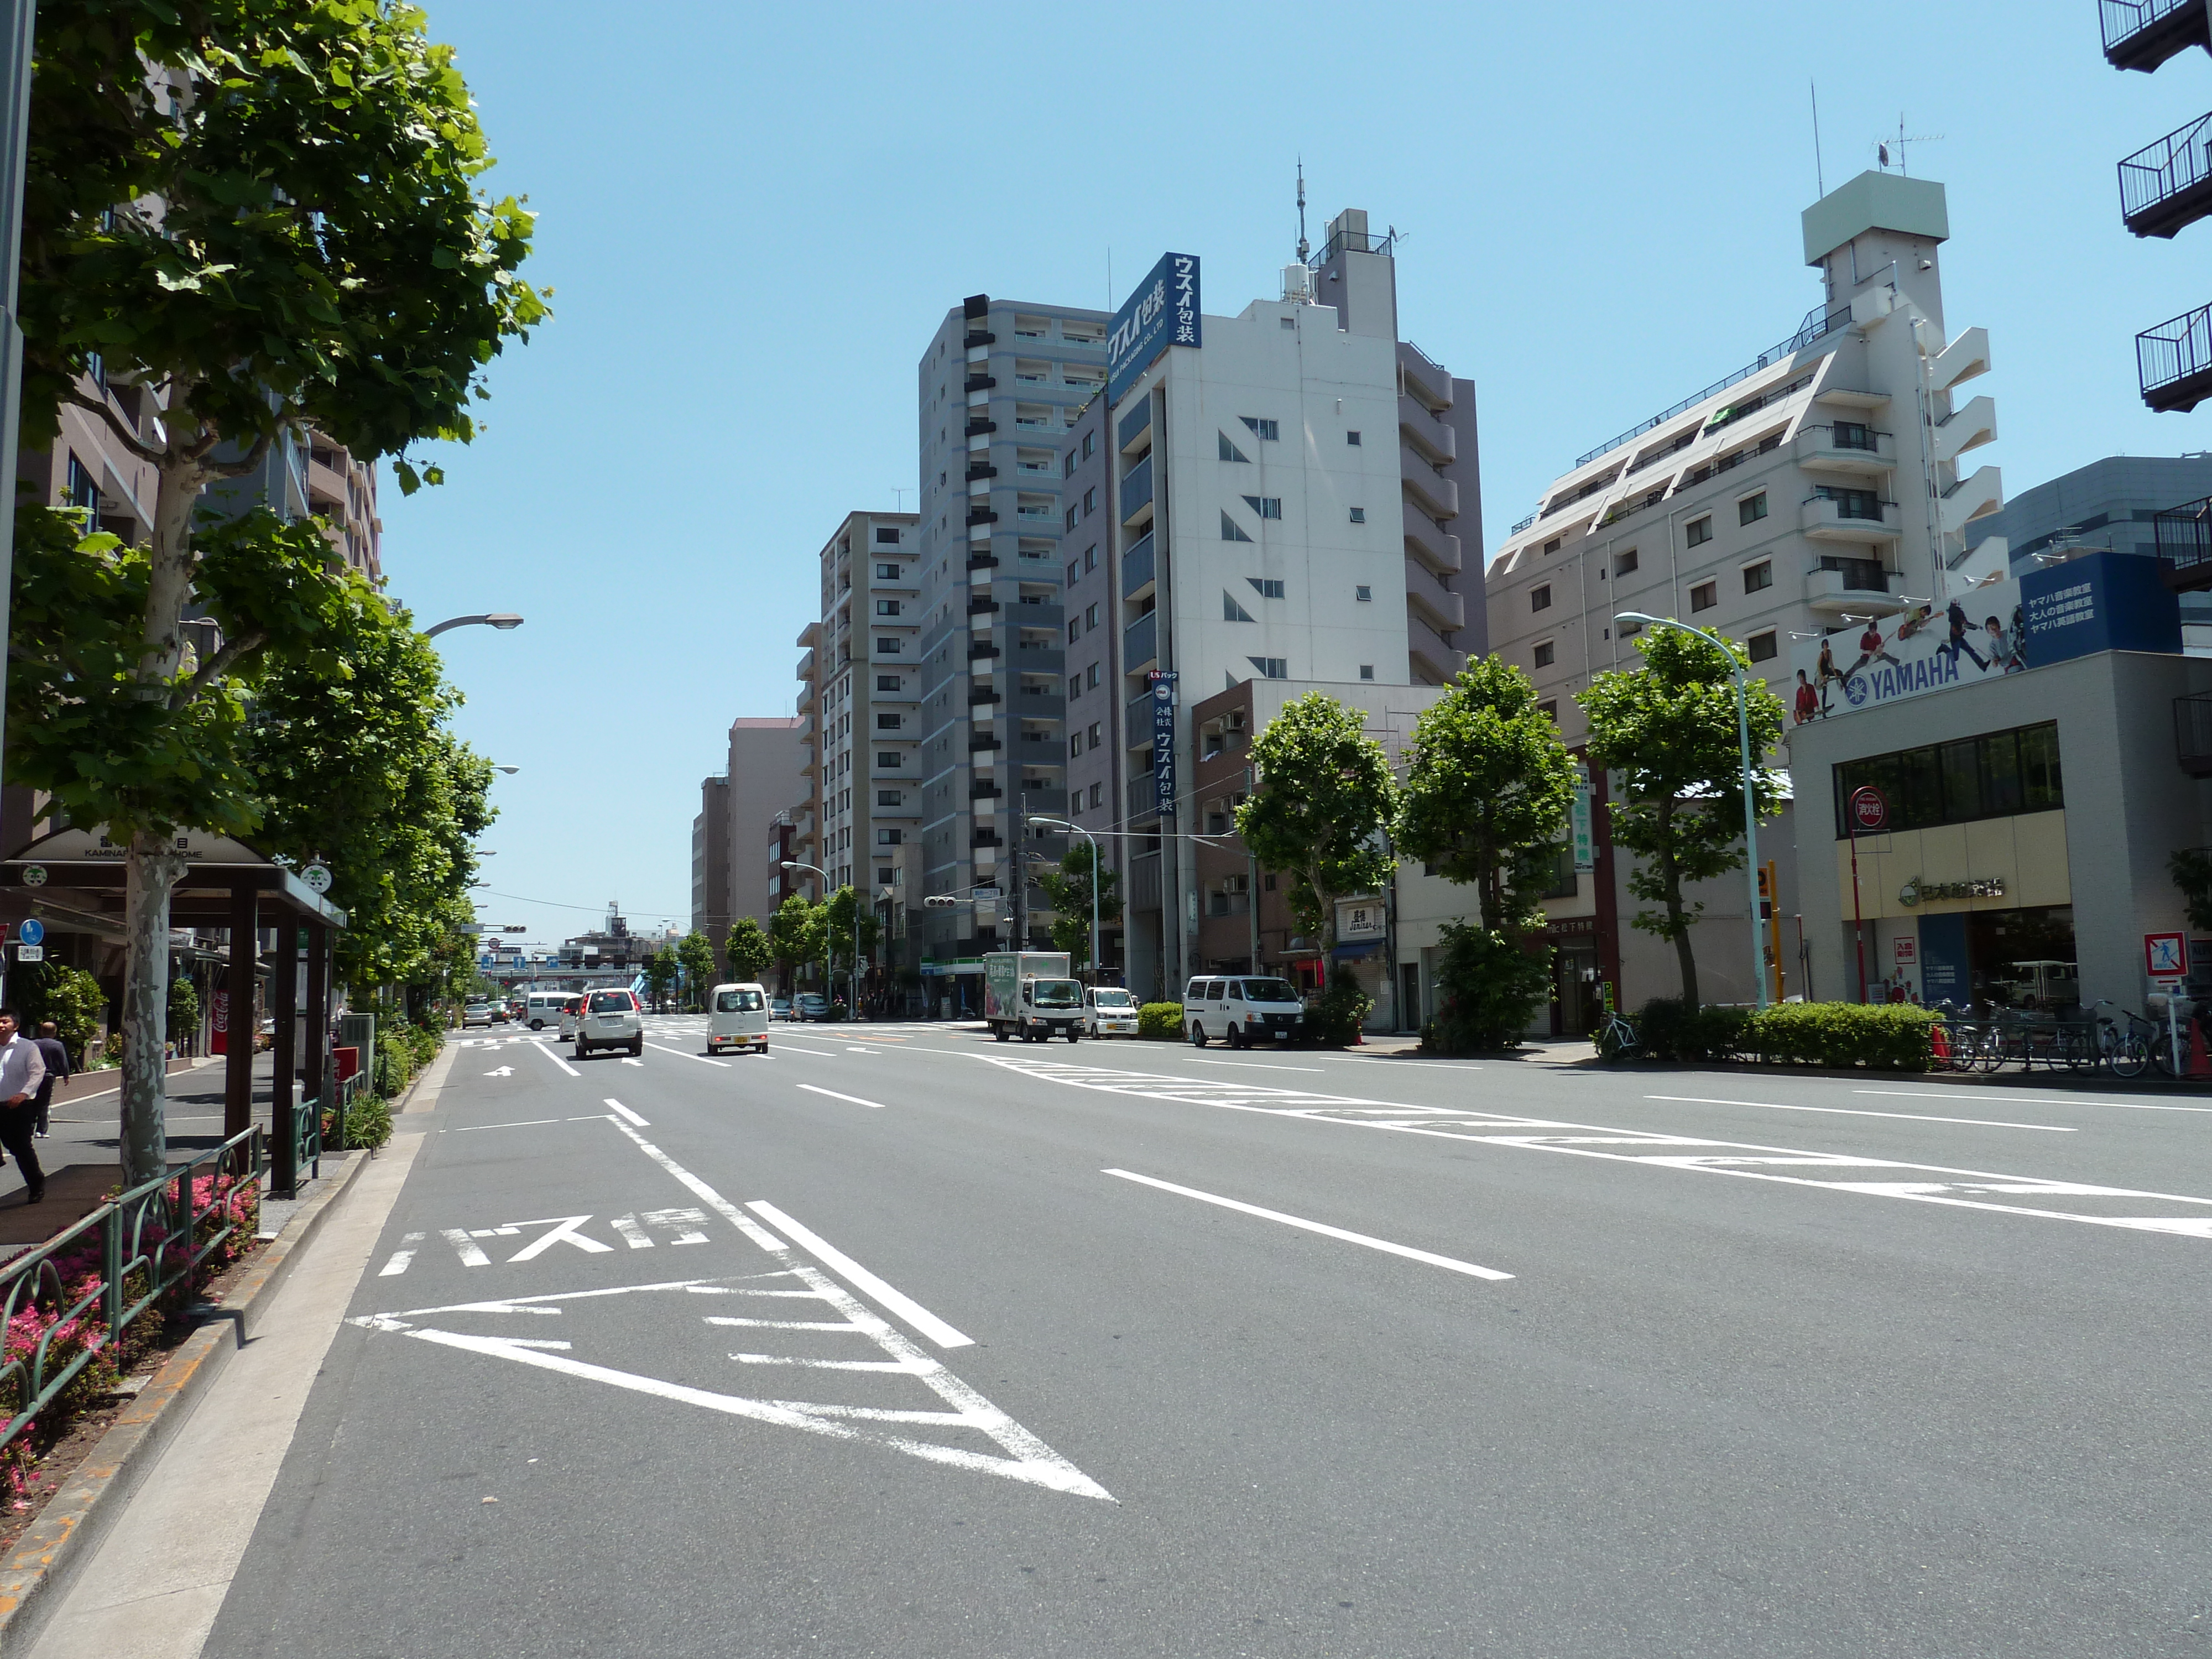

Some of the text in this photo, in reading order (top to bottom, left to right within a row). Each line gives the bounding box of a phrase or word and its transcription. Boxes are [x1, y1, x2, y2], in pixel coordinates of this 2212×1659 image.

[1108, 279, 1165, 366] ウスイ包装
[1175, 257, 1194, 343] ウスイ包装
[1109, 368, 1120, 383] USUI
[1120, 342, 1144, 374] PACKAGING
[1154, 319, 1164, 334] LTD
[2029, 582, 2092, 608] ヤマハ音楽教室
[2029, 596, 2093, 622] 大人の音楽教室
[2030, 609, 2094, 633] ヤマハ英語教室
[1870, 650, 1959, 700] YAMAHA
[1157, 732, 1173, 812] ウスイ包装
[1858, 803, 1881, 816] 消火栓
[378, 1207, 712, 1277] バス停
